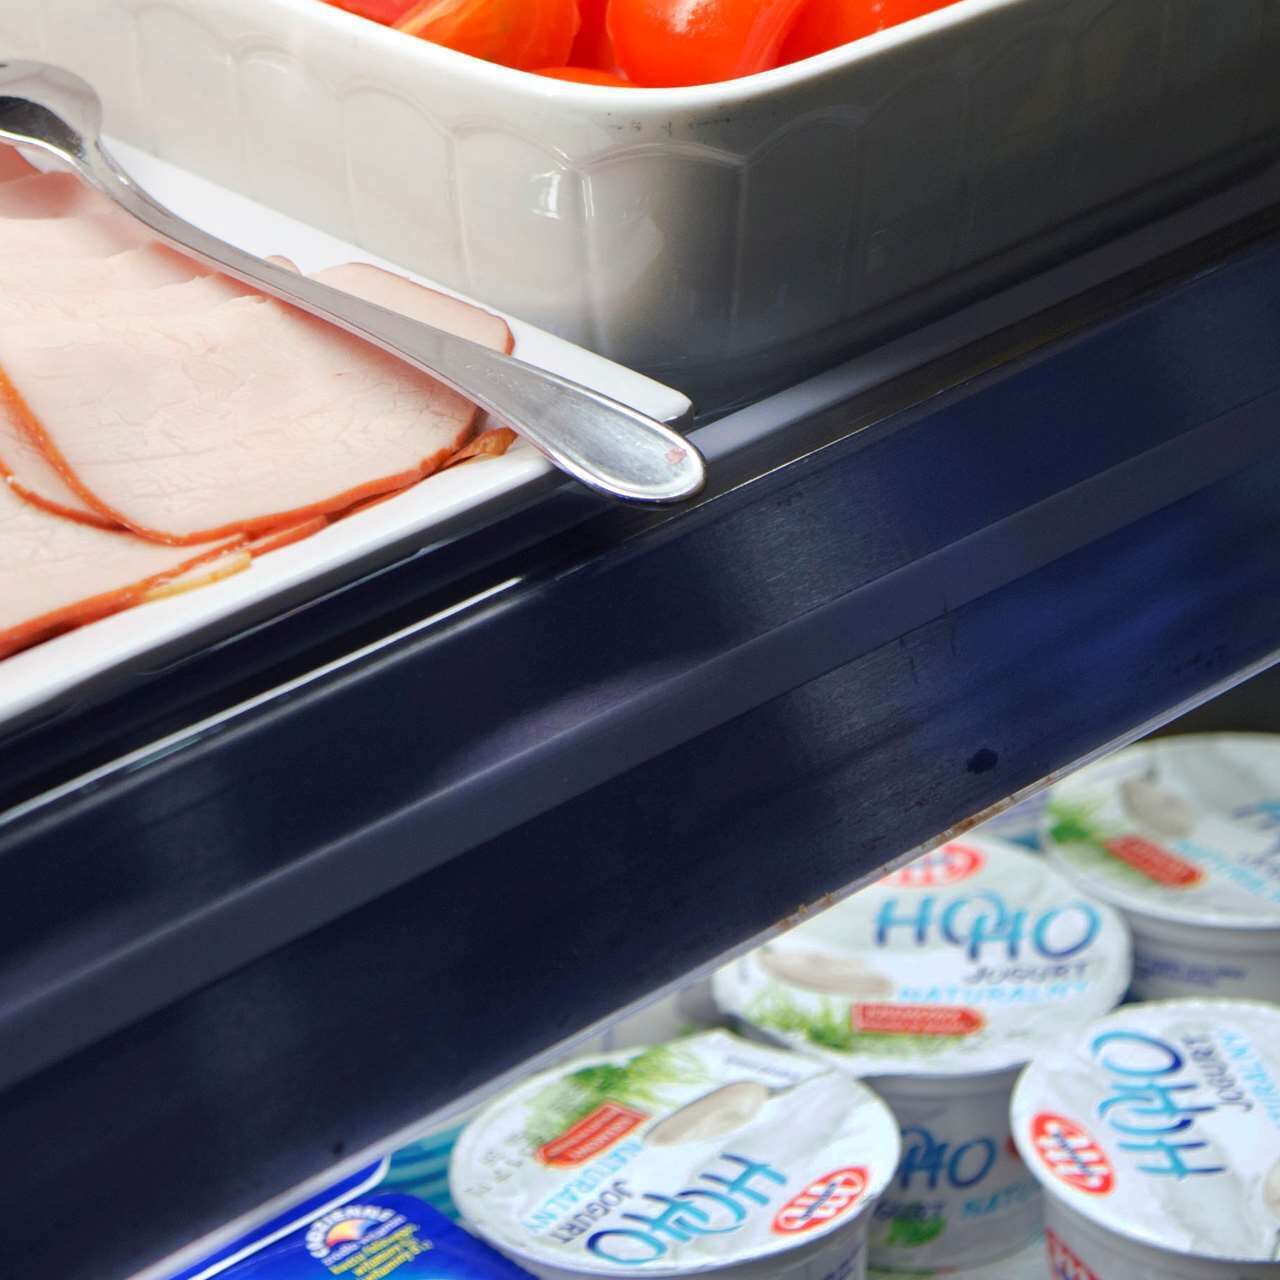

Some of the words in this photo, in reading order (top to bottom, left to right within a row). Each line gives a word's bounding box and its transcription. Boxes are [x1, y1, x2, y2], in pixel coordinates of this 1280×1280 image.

[1182, 1033, 1253, 1113] JOGURT
[523, 1140, 643, 1235] NATURALNY
[549, 1178, 633, 1244] JOGURT
